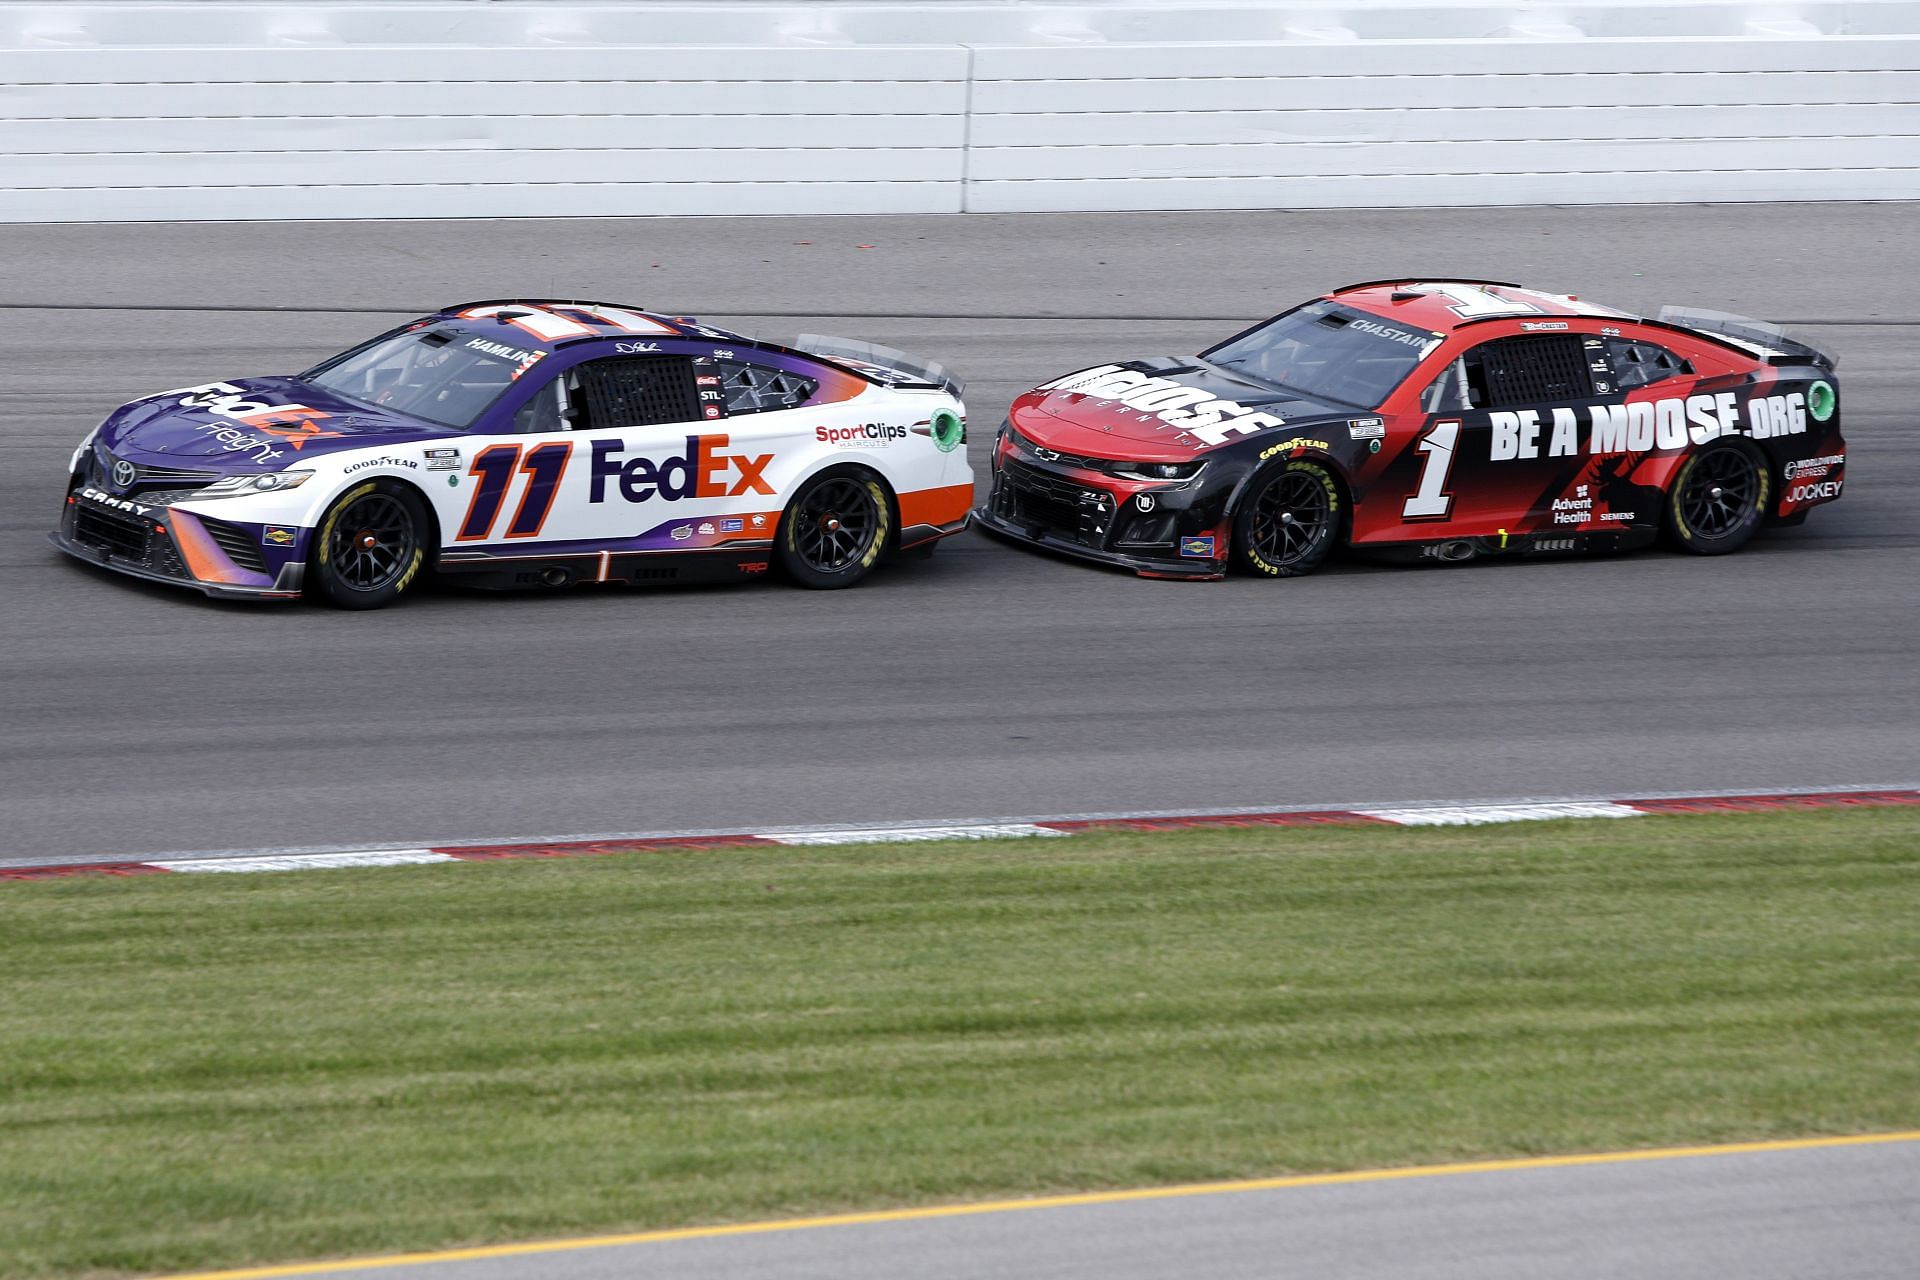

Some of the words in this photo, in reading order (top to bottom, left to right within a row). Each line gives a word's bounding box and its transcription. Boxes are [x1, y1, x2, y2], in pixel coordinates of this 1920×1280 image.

[1350, 319, 1430, 349] CHASTAIN
[464, 338, 534, 363] HAMLIN
[700, 390, 722, 400] STL
[1034, 364, 1286, 447] MOOSE
[195, 420, 284, 465] Freight
[1488, 409, 1541, 461] BE
[1548, 407, 1578, 456] A
[1259, 437, 1329, 460] GOODYEAR
[343, 455, 419, 474] GOODYEAR
[589, 433, 777, 504] FedEx
[1400, 419, 1462, 523] 1
[1797, 465, 1828, 479] EXPRESS
[454, 440, 574, 542] 11
[1785, 480, 1843, 503] JOCKEY
[1551, 497, 1592, 511] Advent
[1553, 510, 1592, 524] Health
[1599, 512, 1635, 521] SIEMENS
